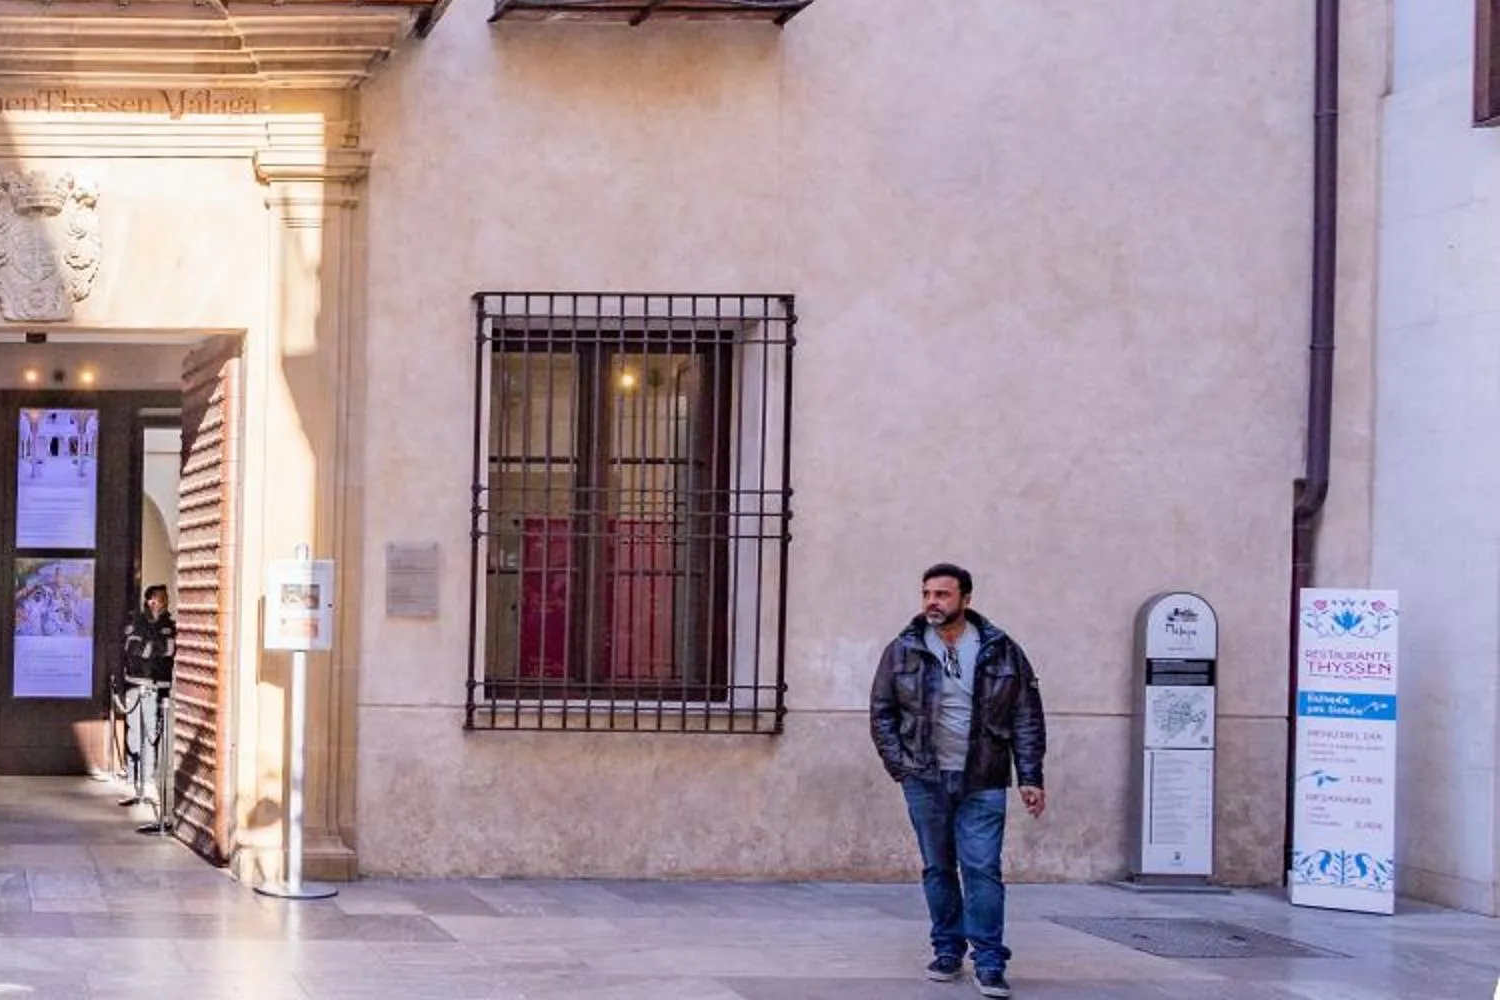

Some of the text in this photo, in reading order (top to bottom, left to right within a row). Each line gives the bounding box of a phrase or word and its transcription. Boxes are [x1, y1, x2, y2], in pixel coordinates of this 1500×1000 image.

[38, 88, 152, 119] Thyssen
[159, 87, 259, 120] Málaga
[1305, 648, 1391, 661] RESTAURANTE
[1306, 660, 1391, 675] THYSSEN
